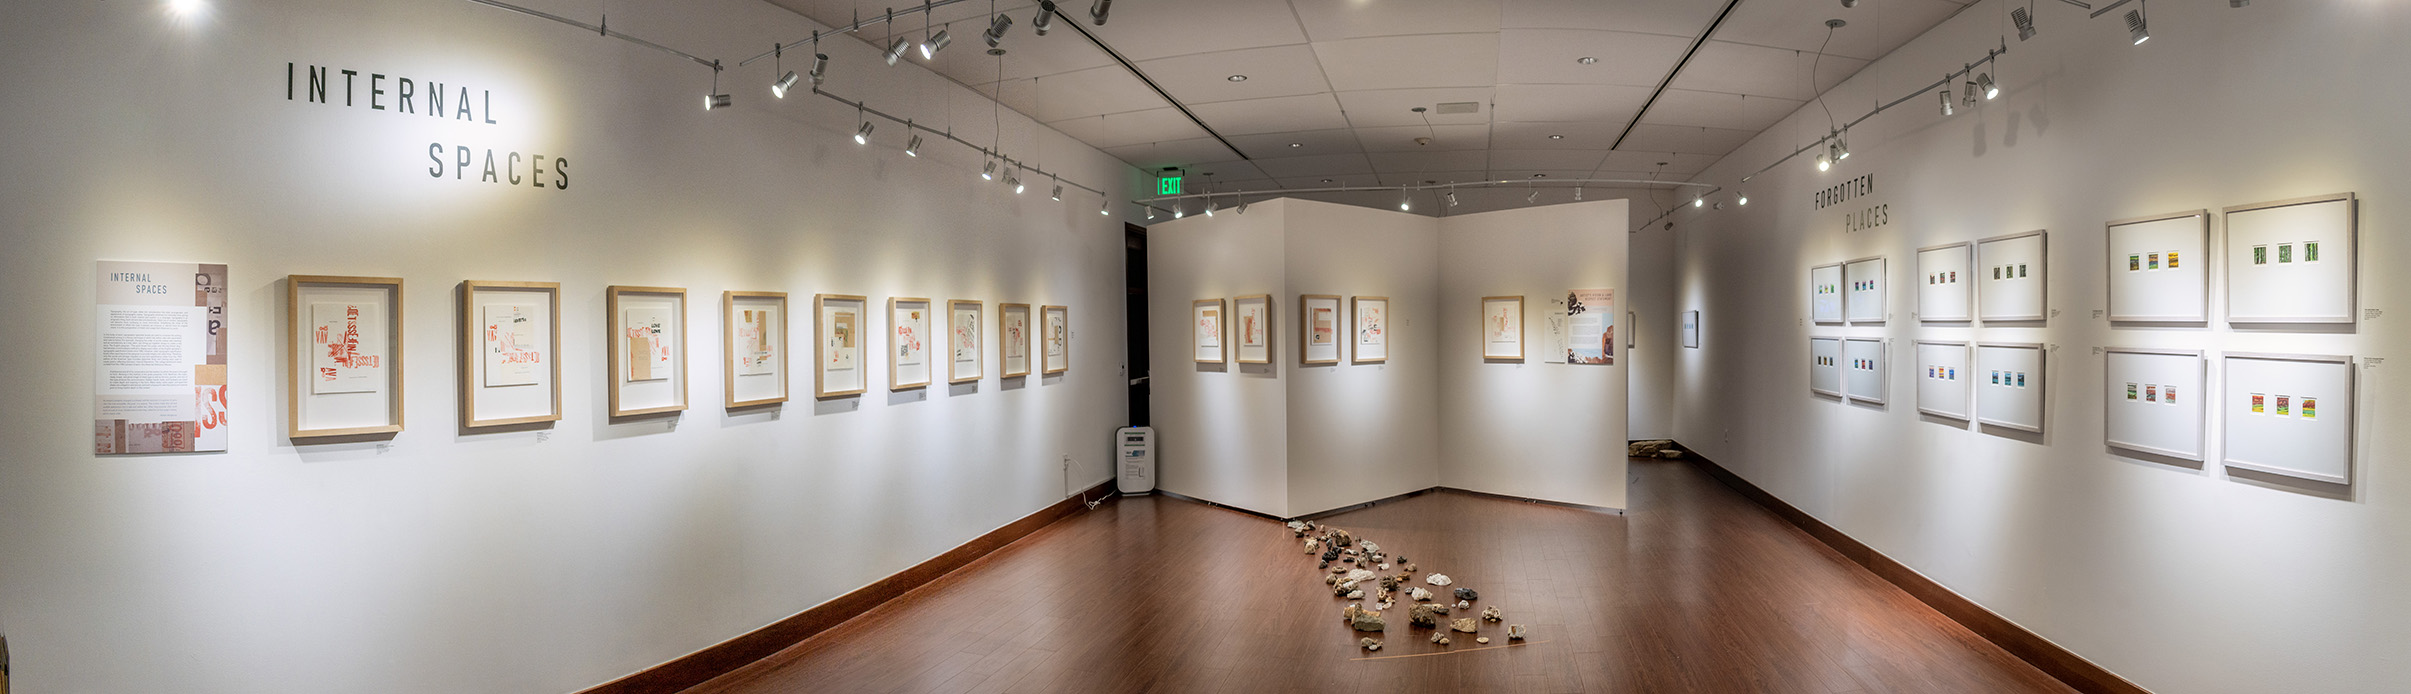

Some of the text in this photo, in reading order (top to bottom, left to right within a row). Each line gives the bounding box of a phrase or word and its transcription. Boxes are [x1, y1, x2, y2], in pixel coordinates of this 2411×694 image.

[287, 62, 497, 125] INTERNAL
[428, 143, 569, 191] SPACES
[1161, 176, 1182, 195] EXIT
[1815, 173, 1873, 210] FORGOTTEN
[1845, 203, 1889, 233] PLACES
[110, 272, 151, 282] INTERNAL
[136, 285, 167, 294] SPACES
